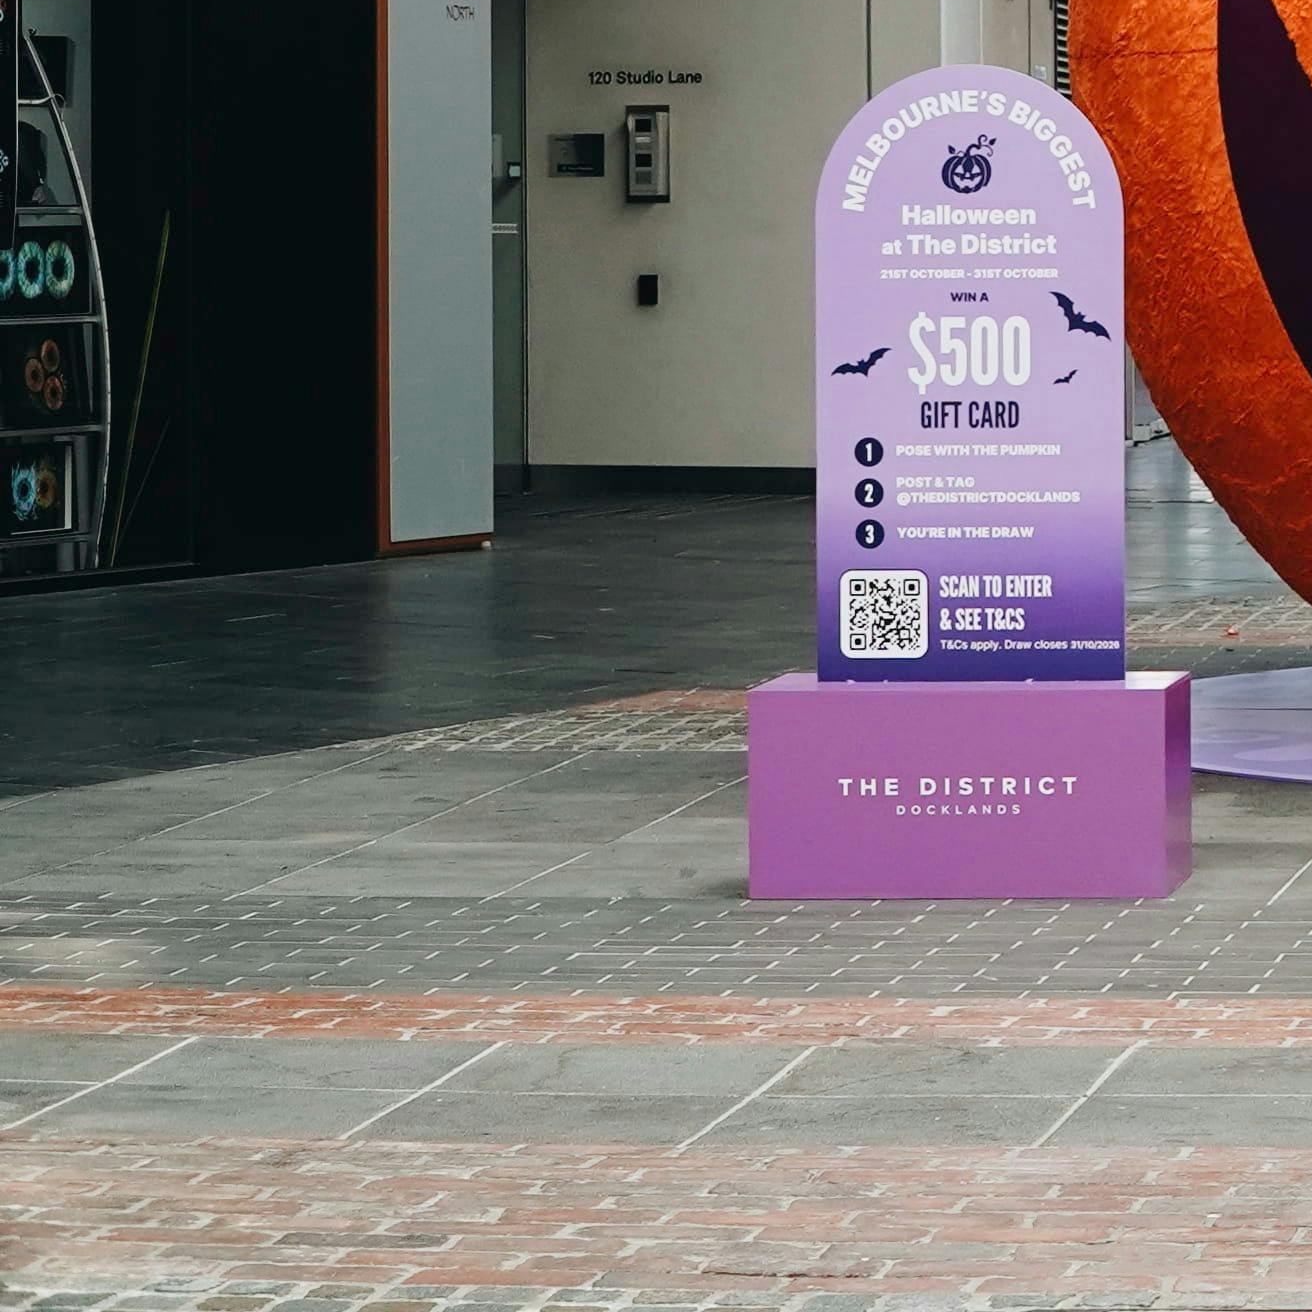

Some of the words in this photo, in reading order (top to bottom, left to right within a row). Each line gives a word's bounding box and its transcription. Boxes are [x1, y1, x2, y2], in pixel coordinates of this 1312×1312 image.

[588, 71, 612, 85] 120
[616, 70, 664, 85] Studio
[668, 70, 703, 84] Lane
[842, 90, 1007, 212] MELBOURNE'S
[1008, 99, 1097, 210] BIGGEST
[902, 205, 1037, 226] Halloween
[881, 240, 902, 255] at
[907, 234, 956, 255] The
[961, 233, 1057, 255] District
[880, 269, 909, 279] 21ST
[910, 269, 965, 279] OCTOBER
[974, 269, 1001, 278] 31ST
[1003, 268, 1059, 278] OCTOBER
[950, 292, 977, 302] WIN
[980, 292, 989, 302] A
[907, 312, 1031, 395] $500
[921, 401, 962, 429] GIFT
[968, 401, 1020, 429] CARD
[865, 442, 873, 462] 1
[896, 445, 931, 456] POSE
[934, 445, 970, 456] WITH
[972, 445, 1000, 456] THE
[1000, 445, 1061, 455] PUMPKIN
[896, 476, 932, 488] POST
[934, 477, 944, 488] &
[946, 476, 975, 488] TAG
[864, 483, 874, 503] 2
[896, 491, 1081, 506] @THEDISTRICTDOCKLANDS
[865, 524, 874, 544] 3
[897, 527, 946, 538] YOU'RE
[948, 527, 961, 538] IN
[963, 527, 991, 538] THE
[992, 527, 1034, 538] DRAW
[940, 575, 979, 598] SCAN
[982, 575, 1002, 597] TO
[1005, 575, 1053, 597] ENTER
[940, 608, 952, 630] &
[955, 608, 982, 630] SEE
[984, 608, 1025, 630] T&CS
[940, 640, 968, 650] T&Cs
[970, 640, 1001, 652] apply.
[1004, 640, 1032, 650] Draw
[1034, 639, 1068, 650] closes
[838, 778, 899, 796] THE
[920, 777, 1077, 795] DISTRICT
[896, 804, 1021, 815] DOCKLANDS
